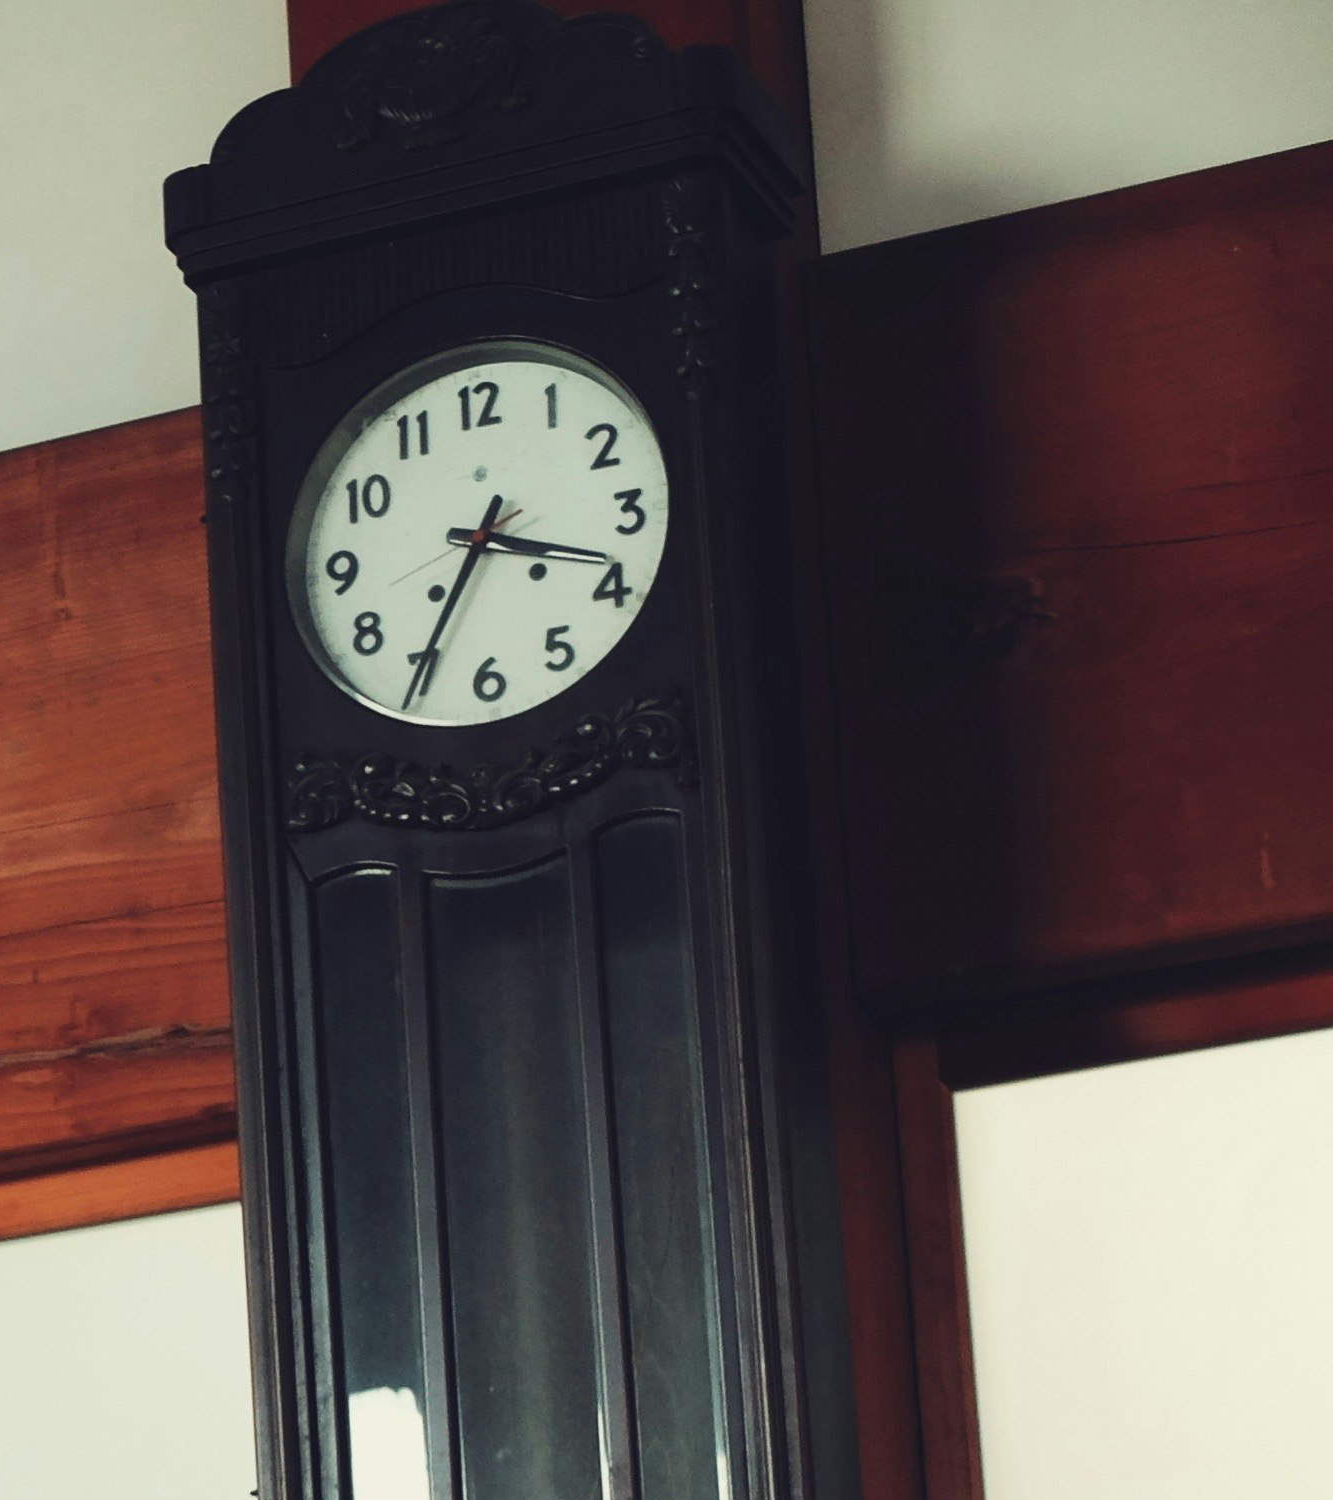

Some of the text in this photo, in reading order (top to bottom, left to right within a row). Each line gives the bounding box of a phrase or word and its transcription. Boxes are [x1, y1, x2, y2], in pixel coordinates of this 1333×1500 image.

[458, 381, 502, 431] 12
[545, 383, 558, 428] 1
[397, 410, 429, 460] 11
[585, 423, 620, 470] 2
[346, 474, 391, 524] 10
[614, 488, 646, 535] 3
[326, 550, 359, 596] 9
[592, 562, 632, 608] 4
[353, 611, 383, 656] 8
[544, 625, 575, 671] 5
[407, 647, 440, 697] 7
[473, 657, 506, 702] 6
